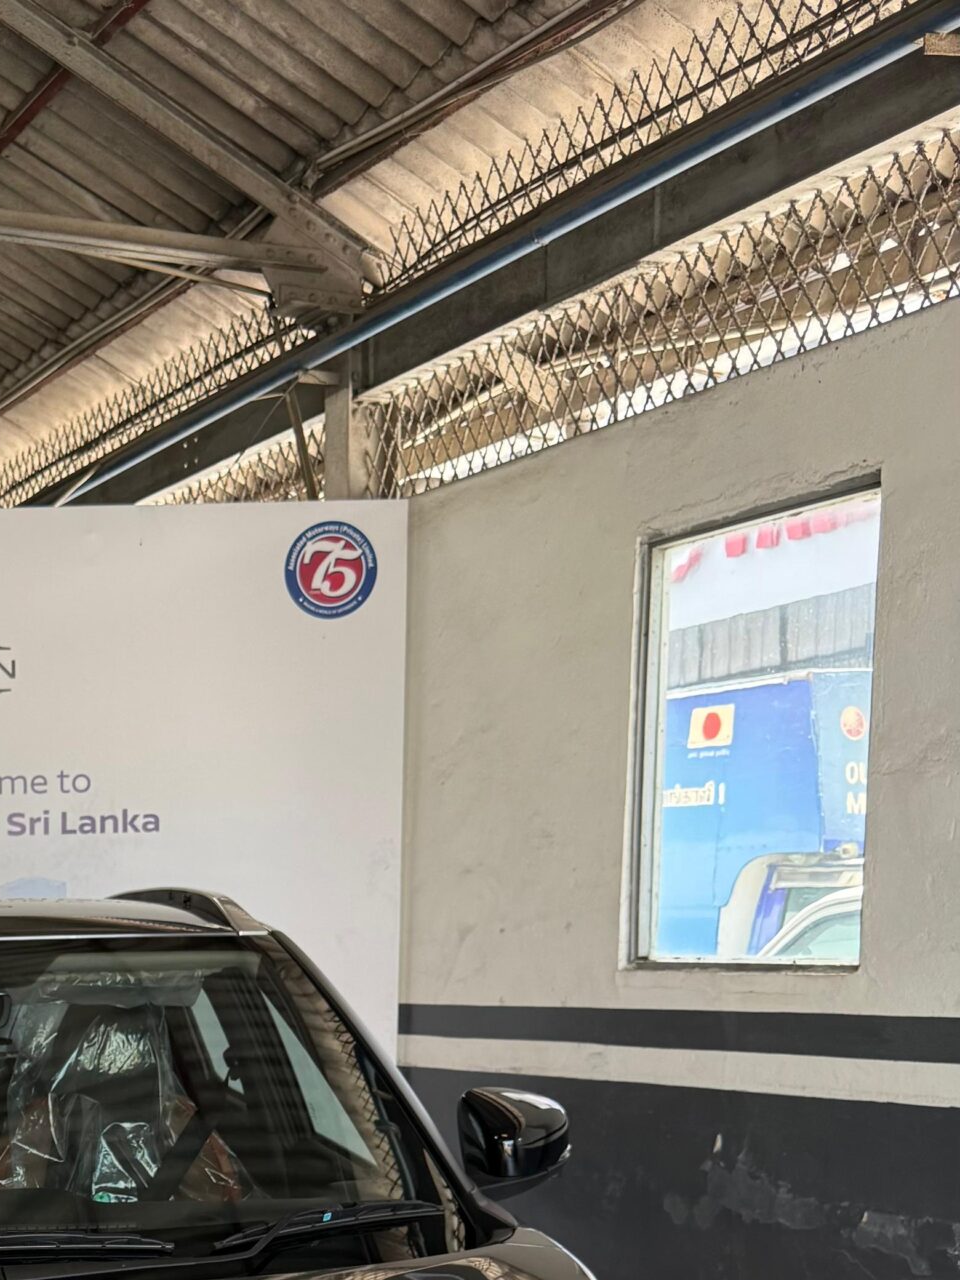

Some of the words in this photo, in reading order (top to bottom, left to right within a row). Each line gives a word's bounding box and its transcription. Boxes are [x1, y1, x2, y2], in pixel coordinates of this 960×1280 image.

[302, 539, 363, 598] 75
[57, 770, 91, 794] to
[6, 810, 50, 837] Sri
[60, 808, 161, 835] Lanka
